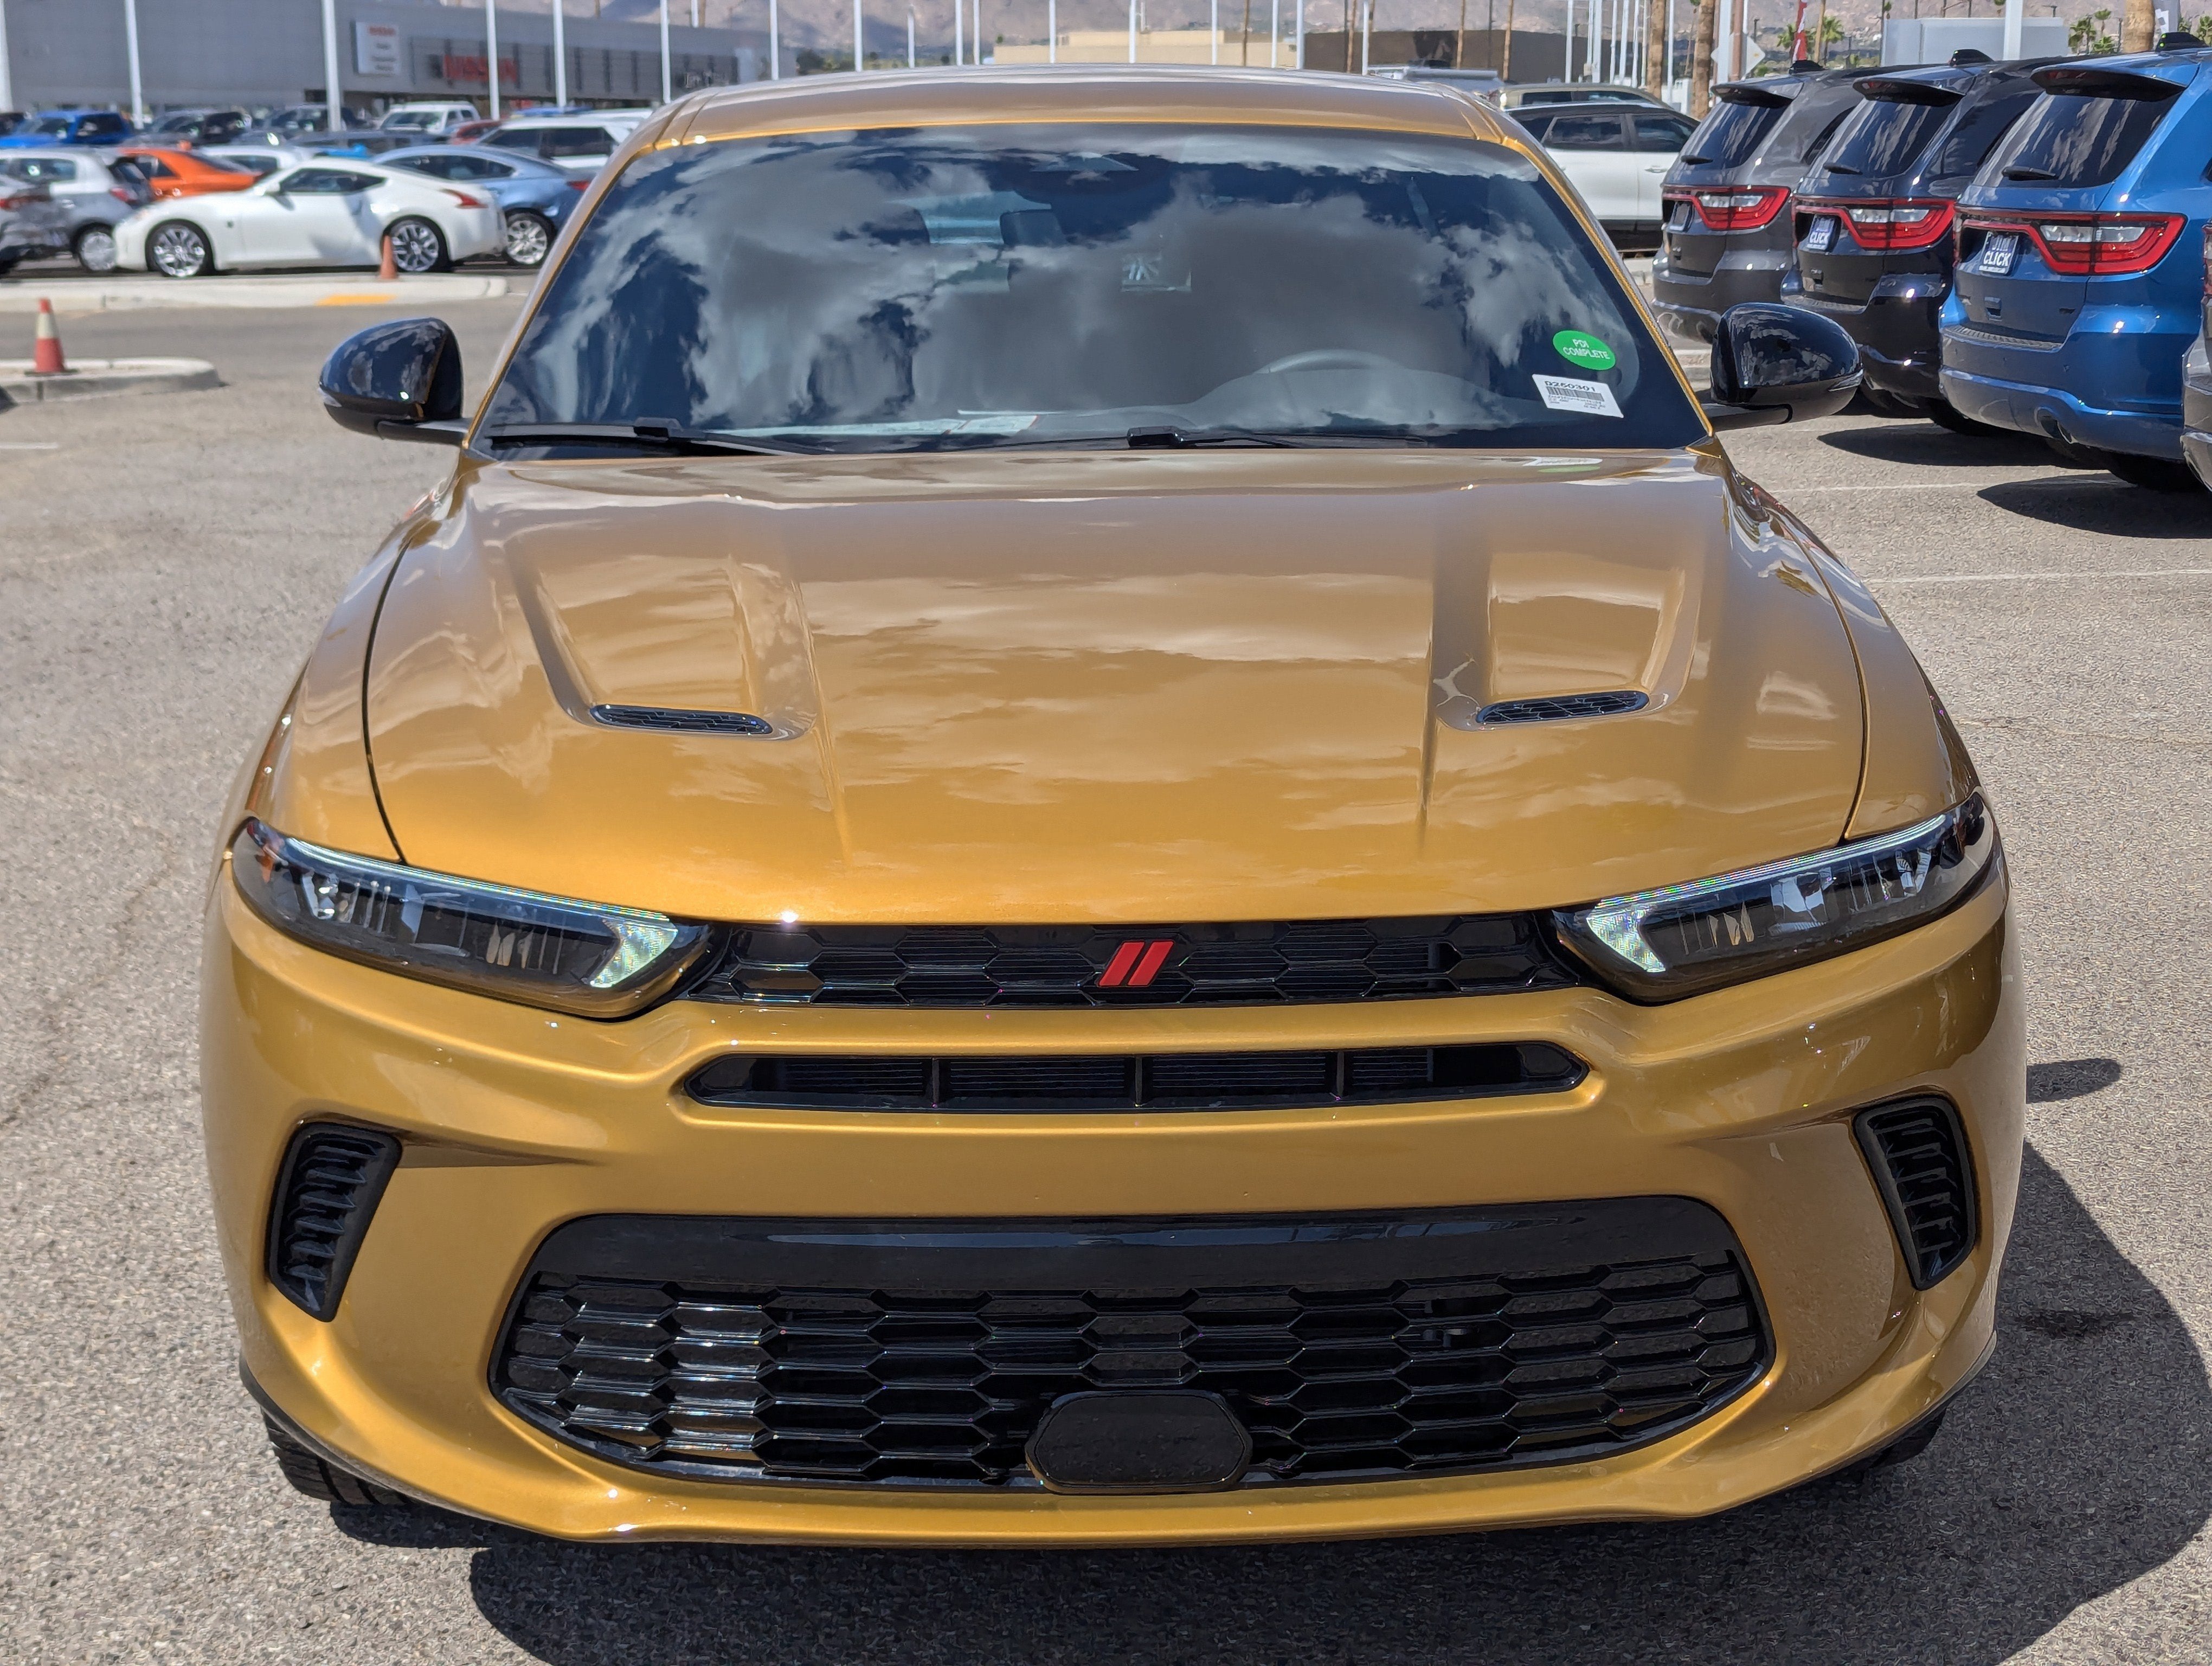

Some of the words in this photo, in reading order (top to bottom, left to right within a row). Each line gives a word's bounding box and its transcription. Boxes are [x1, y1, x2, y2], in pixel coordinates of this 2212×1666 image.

[443, 55, 517, 82] NISSN
[1983, 251, 2011, 266] CLICK
[1572, 339, 1589, 348] PDI
[1563, 347, 1610, 359] COMPLETE
